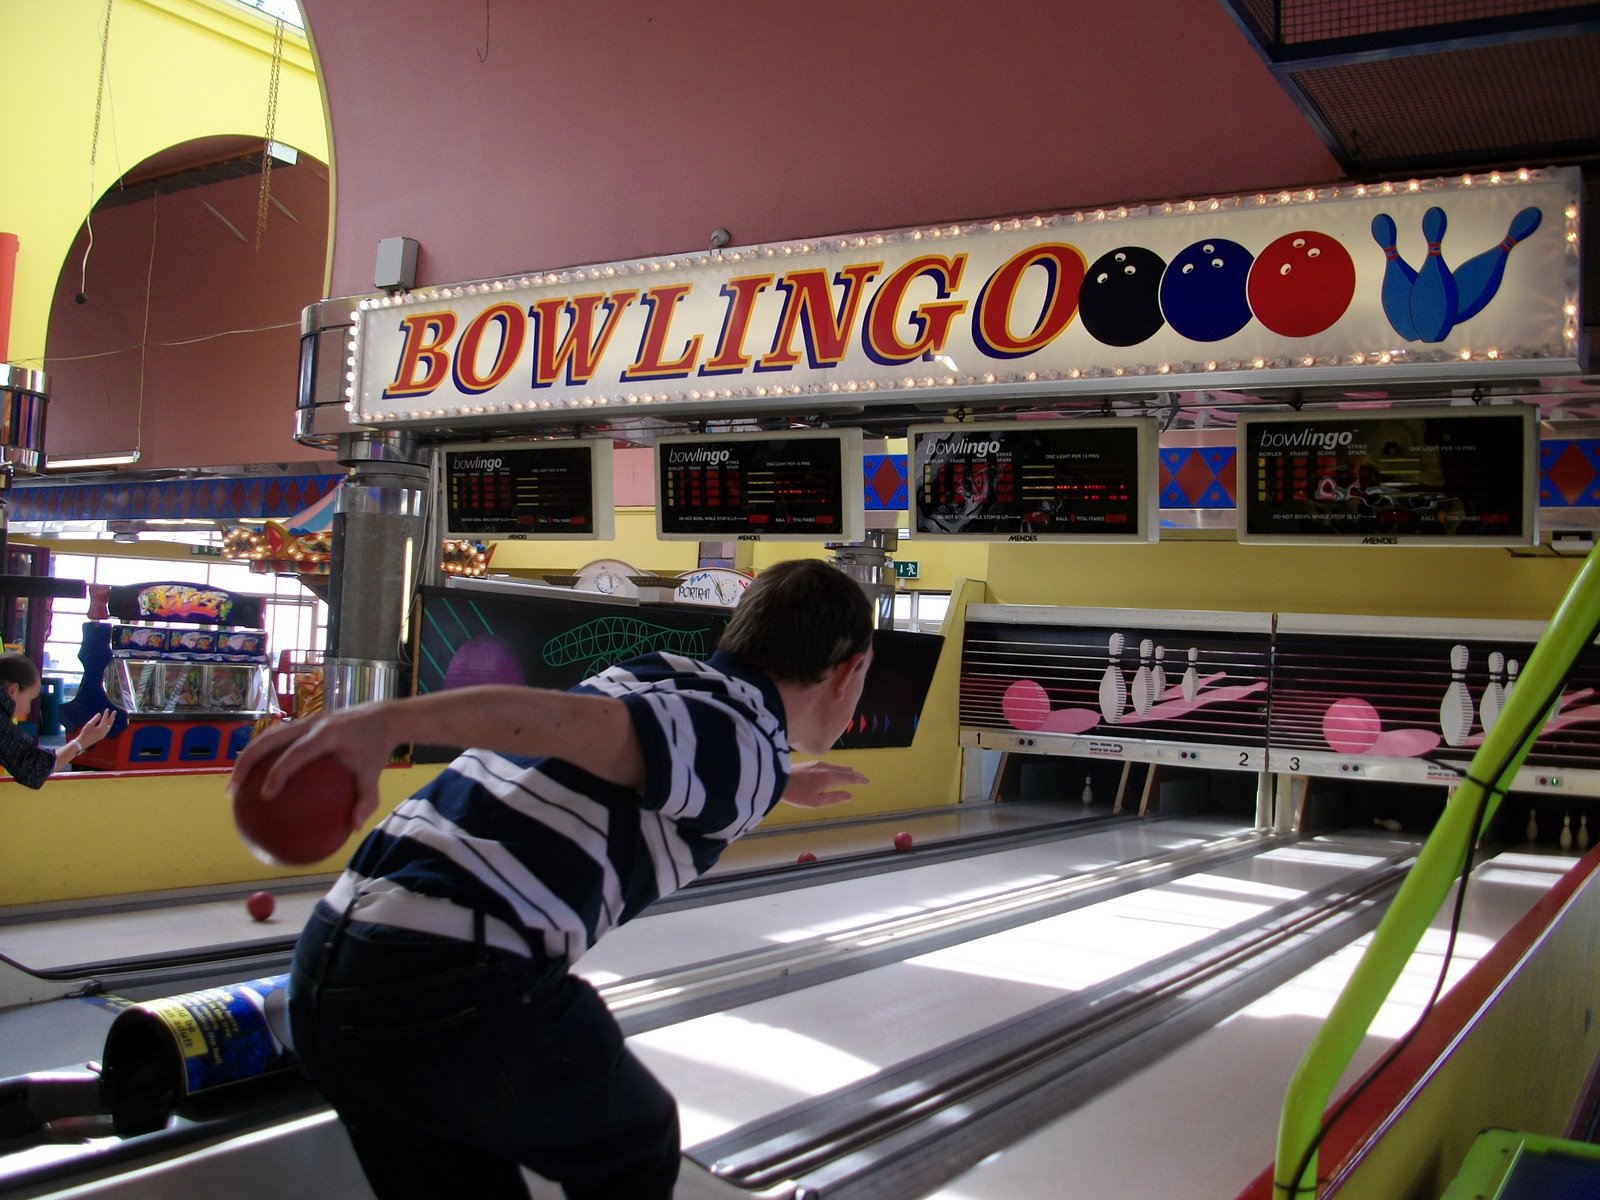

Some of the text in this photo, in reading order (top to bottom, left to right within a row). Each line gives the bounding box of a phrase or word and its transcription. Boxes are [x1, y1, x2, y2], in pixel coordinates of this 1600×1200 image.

[382, 242, 1088, 399] BOWLINGO
[1260, 428, 1353, 450] bowlingo
[668, 447, 730, 465] bowlingo
[926, 438, 1001, 458] bowlingo
[453, 456, 503, 472] bowlingo
[1239, 752, 1249, 767] 2
[1289, 756, 1300, 771] 3
[185, 1019, 196, 1033] be
